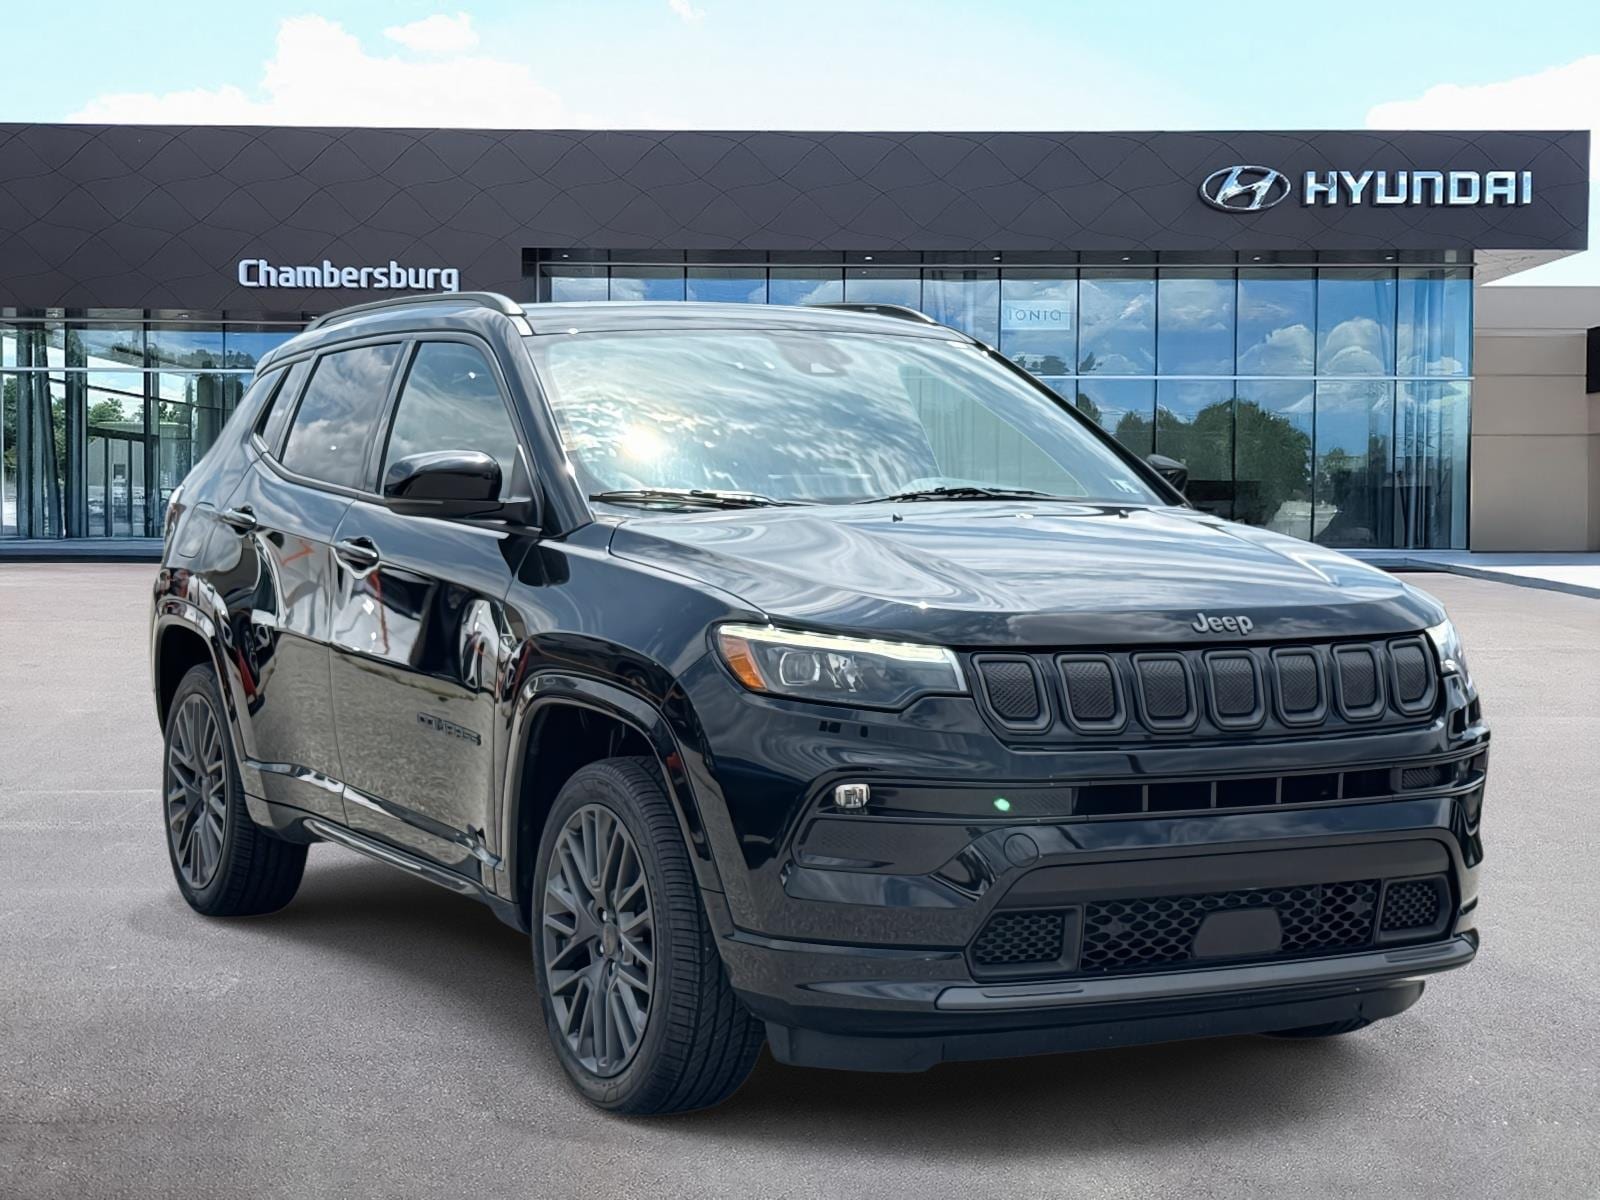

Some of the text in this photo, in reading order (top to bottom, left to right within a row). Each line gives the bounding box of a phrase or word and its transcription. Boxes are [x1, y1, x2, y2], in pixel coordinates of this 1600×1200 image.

[1305, 170, 1532, 205] HYUNDAI
[238, 258, 460, 294] Chambersburg
[1191, 612, 1254, 636] Jeep
